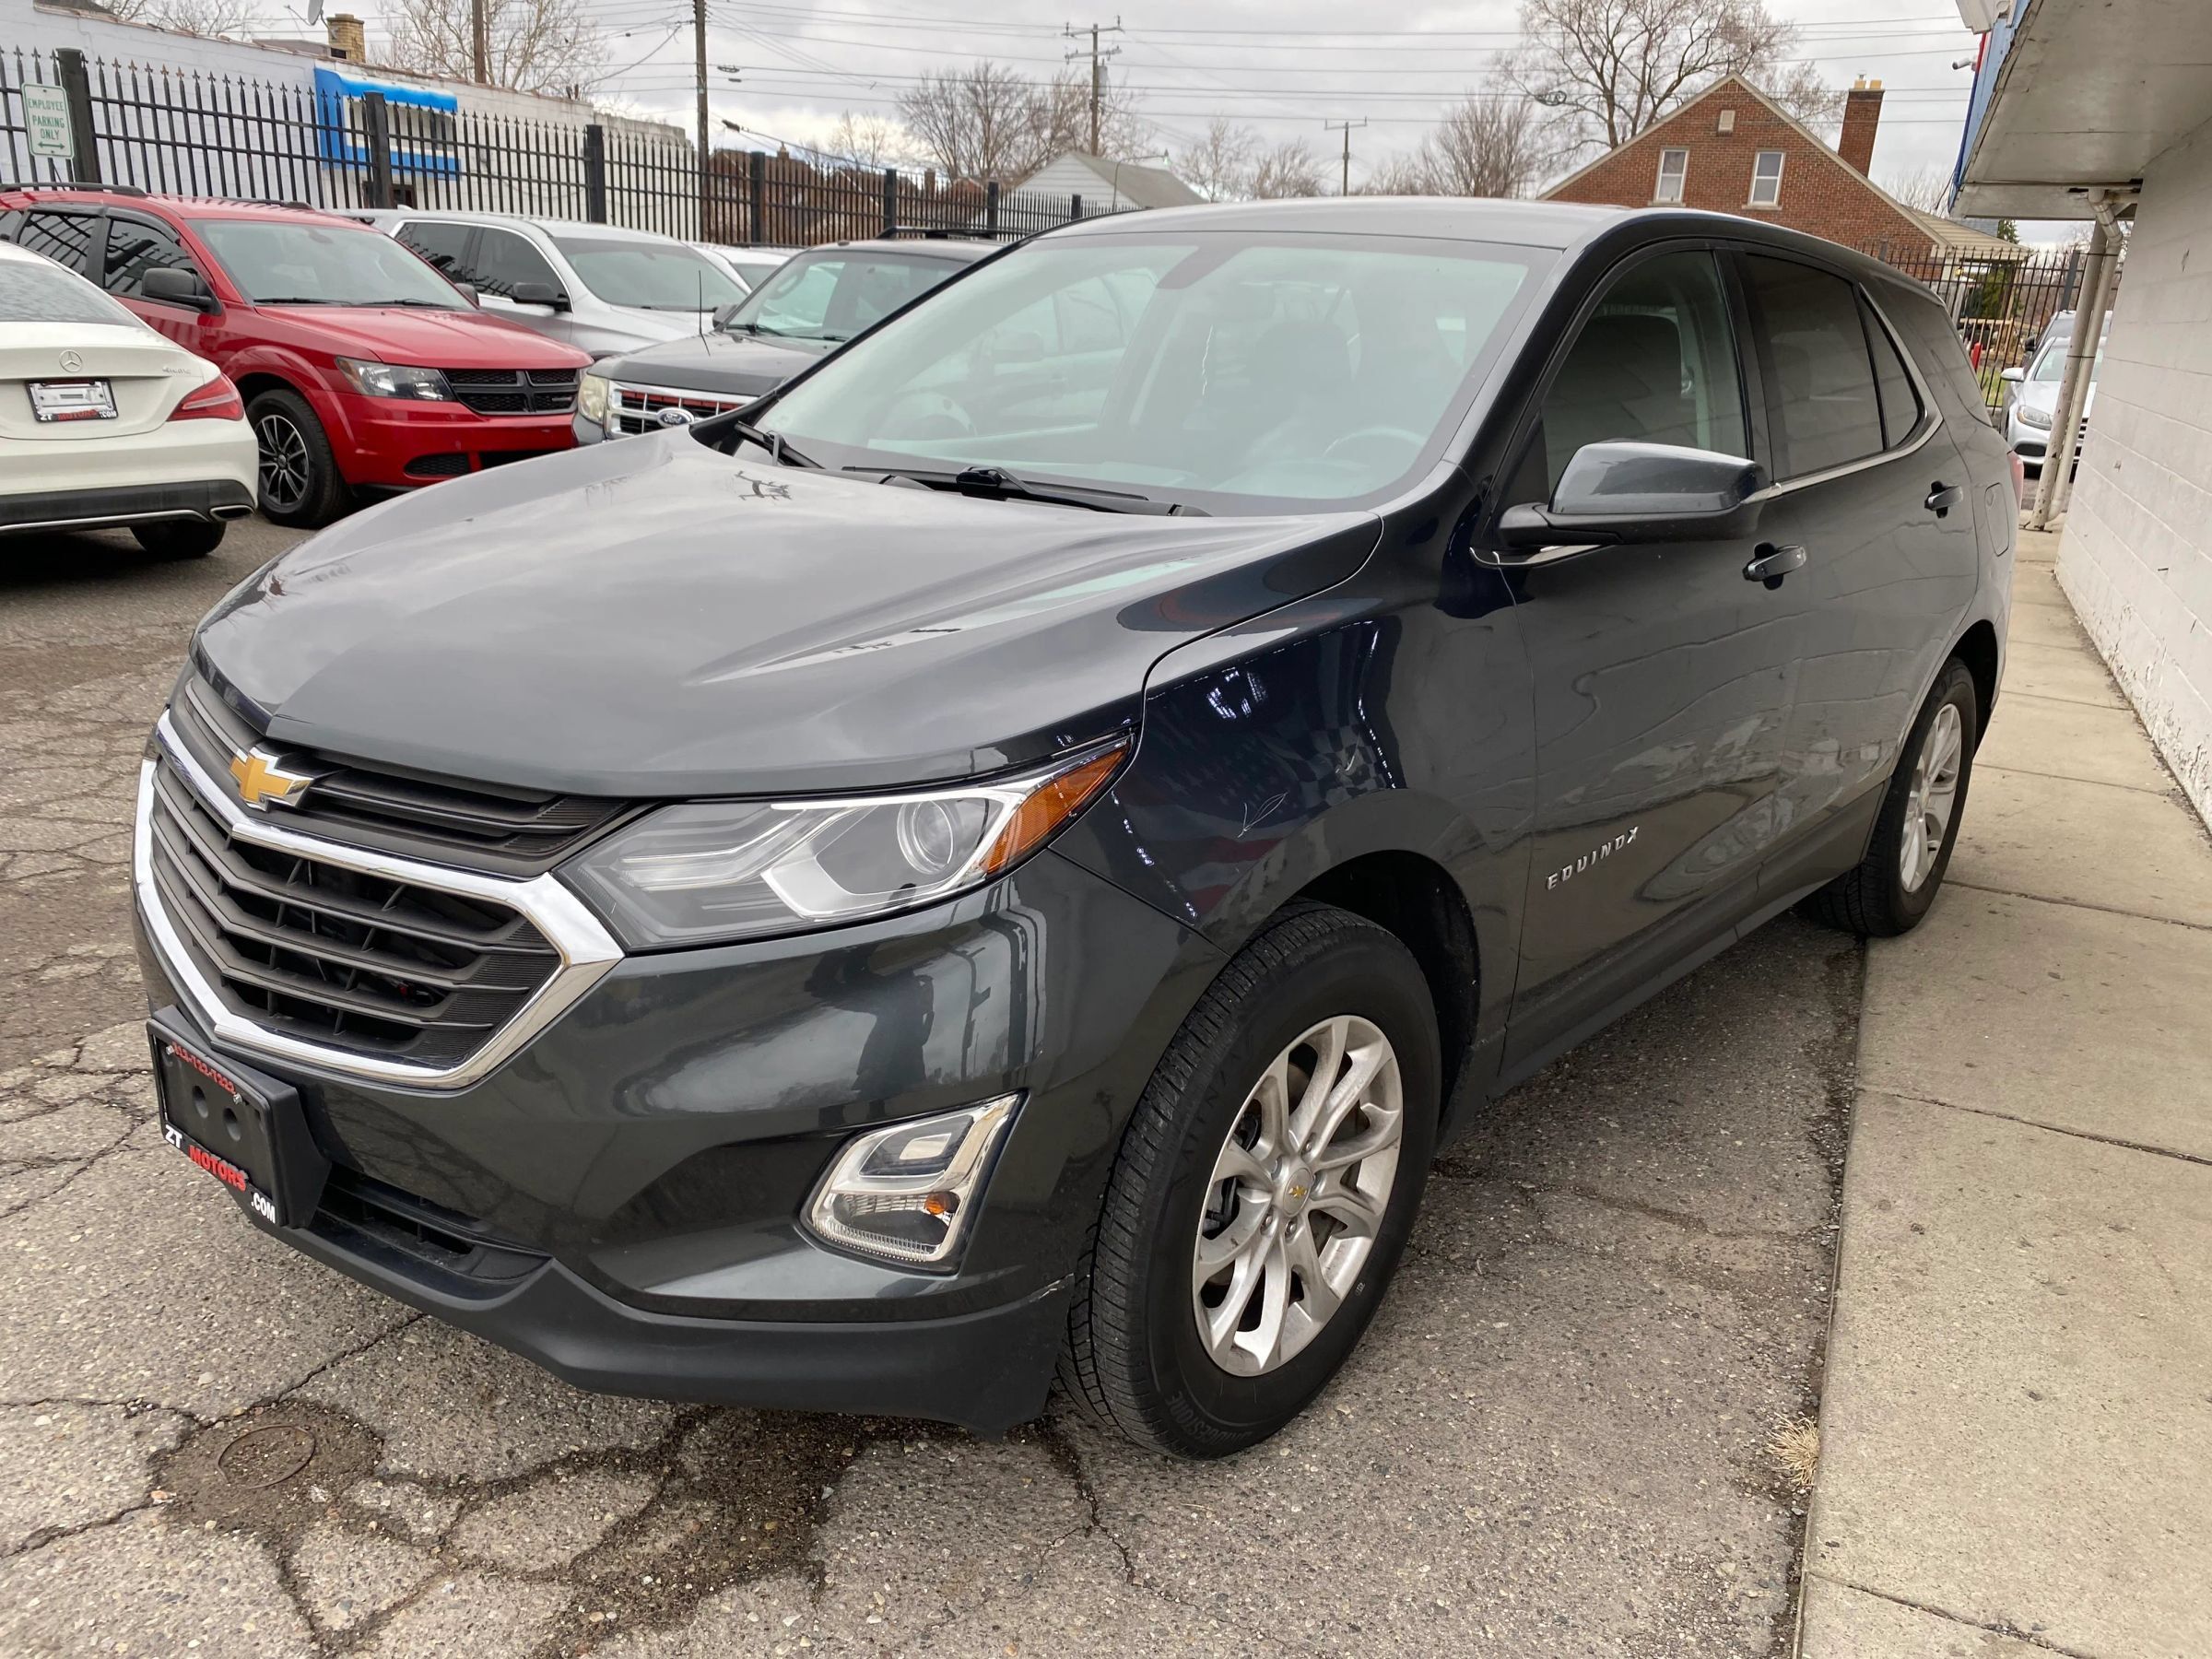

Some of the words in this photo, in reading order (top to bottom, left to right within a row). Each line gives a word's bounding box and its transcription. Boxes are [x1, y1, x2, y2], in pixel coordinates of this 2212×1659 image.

[28, 98, 65, 111] EMPLOYEE
[32, 115, 65, 128] PARKING
[40, 129, 59, 140] ONLY
[1547, 826, 1639, 890] EQUINOX
[165, 1124, 183, 1148] ZT
[189, 1144, 247, 1193] MOTORS
[251, 1192, 276, 1224] .COM
